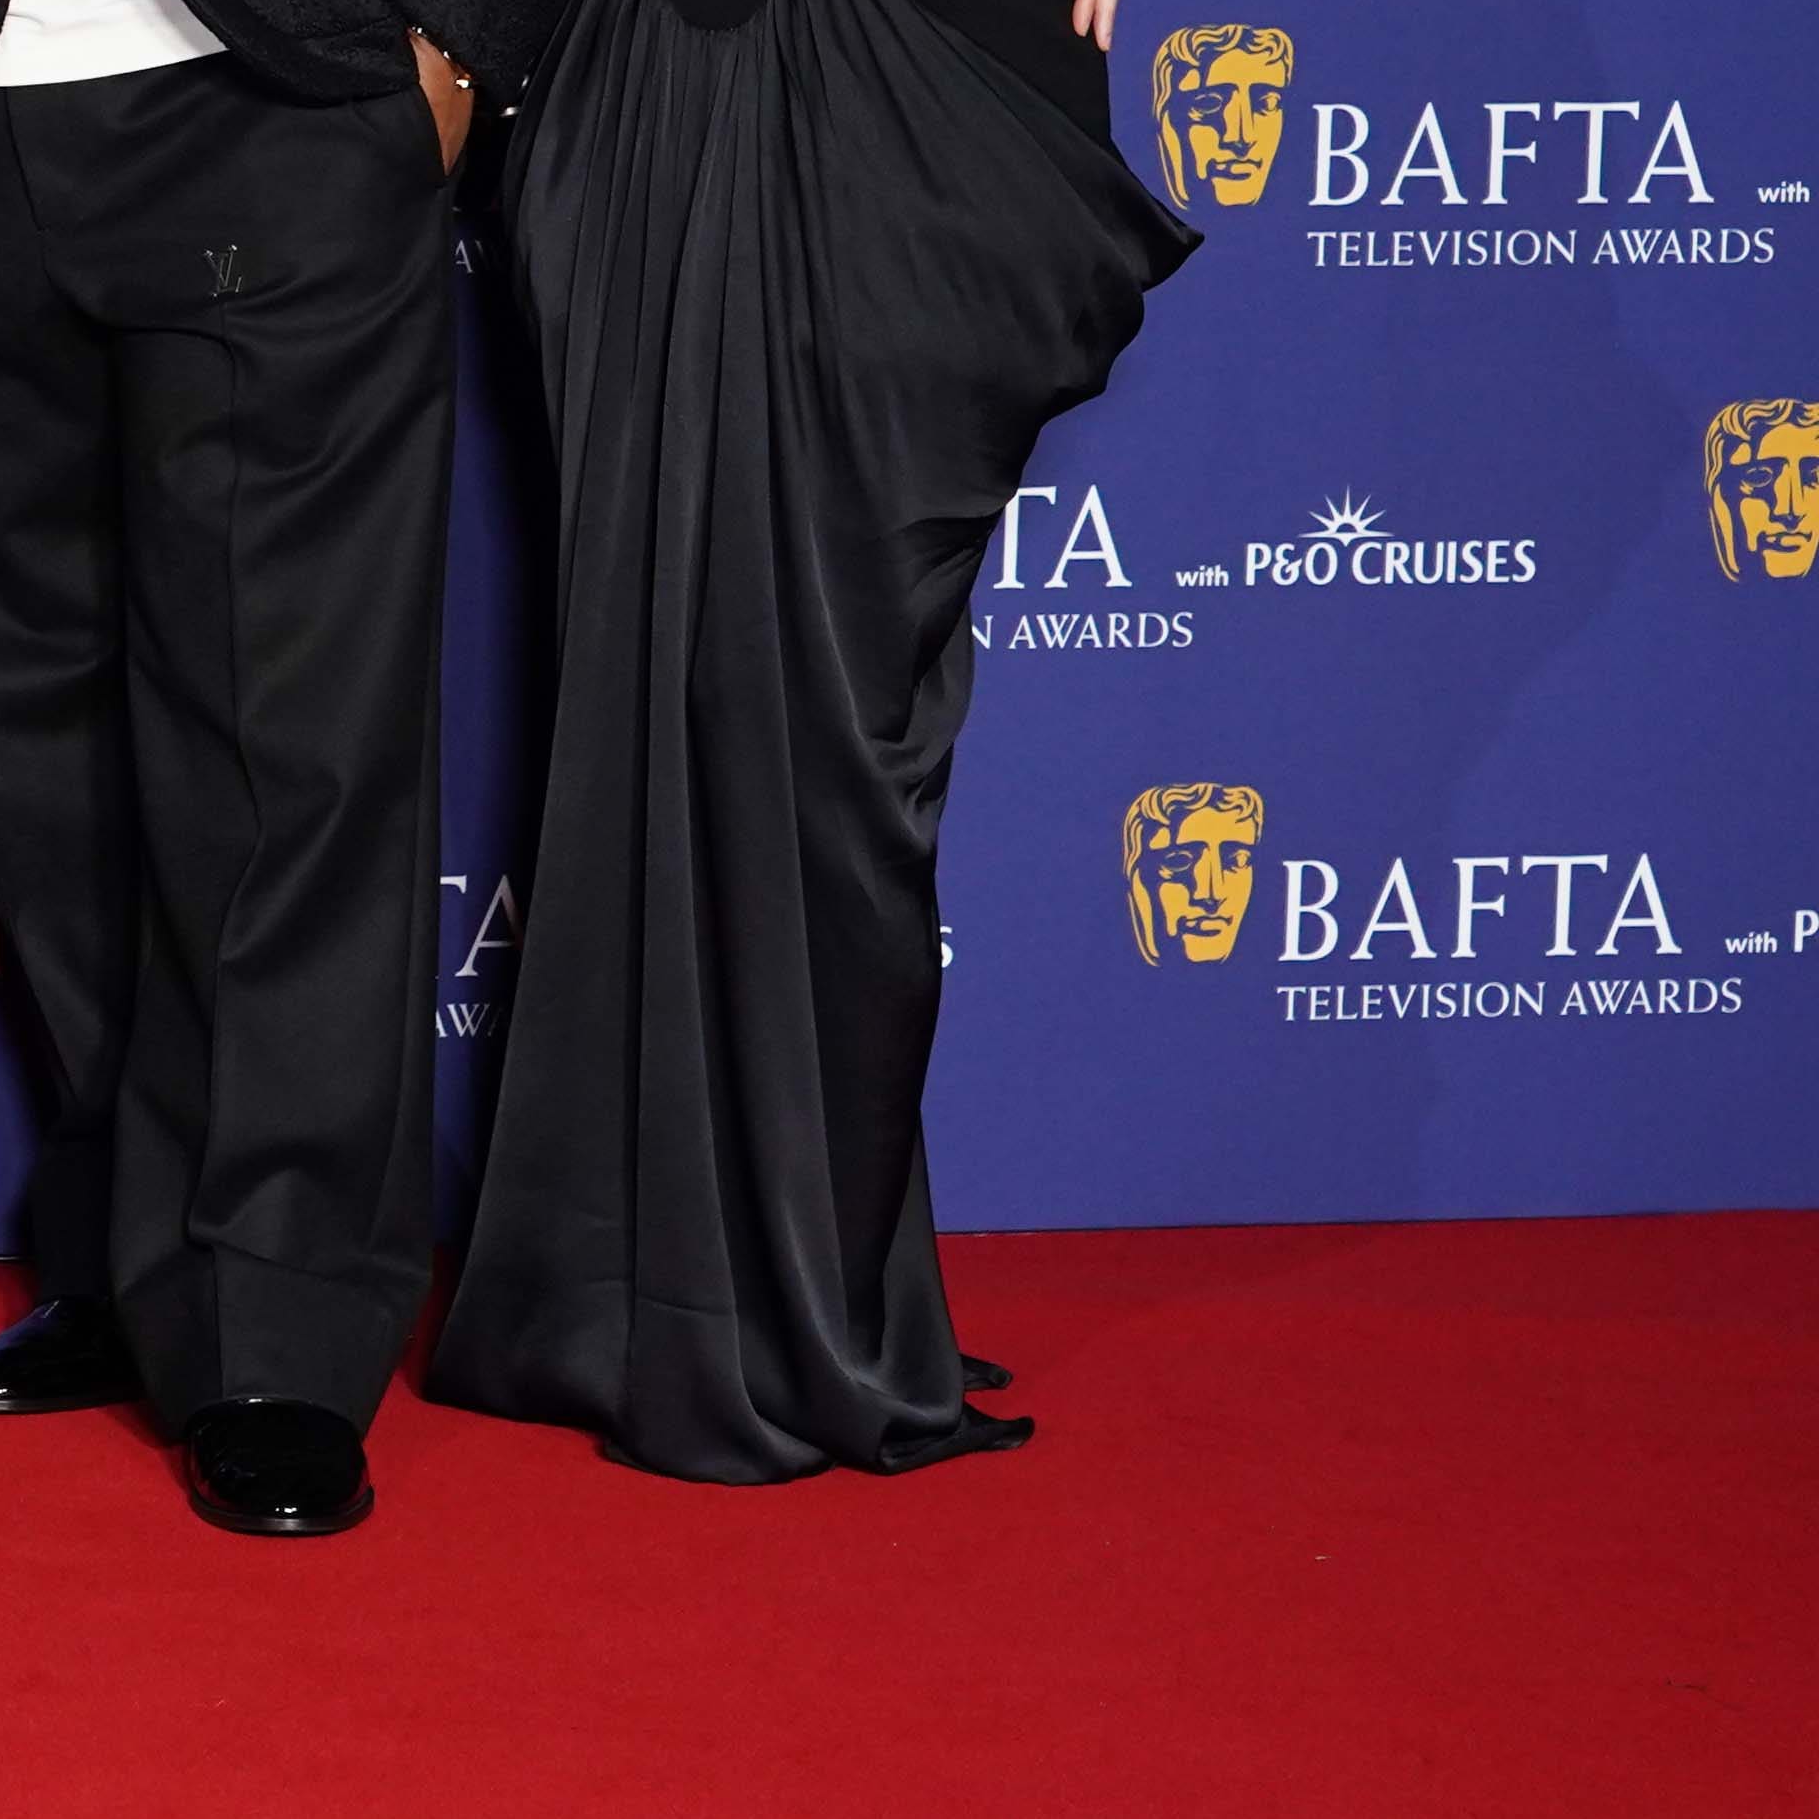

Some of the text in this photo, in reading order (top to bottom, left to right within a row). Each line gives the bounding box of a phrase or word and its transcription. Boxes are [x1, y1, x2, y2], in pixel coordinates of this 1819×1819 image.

[1308, 100, 1715, 206] BAFTA
[1757, 181, 1810, 203] with
[1307, 228, 1774, 267] TELEVISION AWARDS
[1175, 540, 1535, 587] with P&O CRUISES
[1008, 611, 1193, 649] AWARDS
[1278, 853, 1682, 962] BAFTA
[1725, 931, 1778, 954] with
[1276, 978, 1742, 1021] TELEVISION AWARDS
